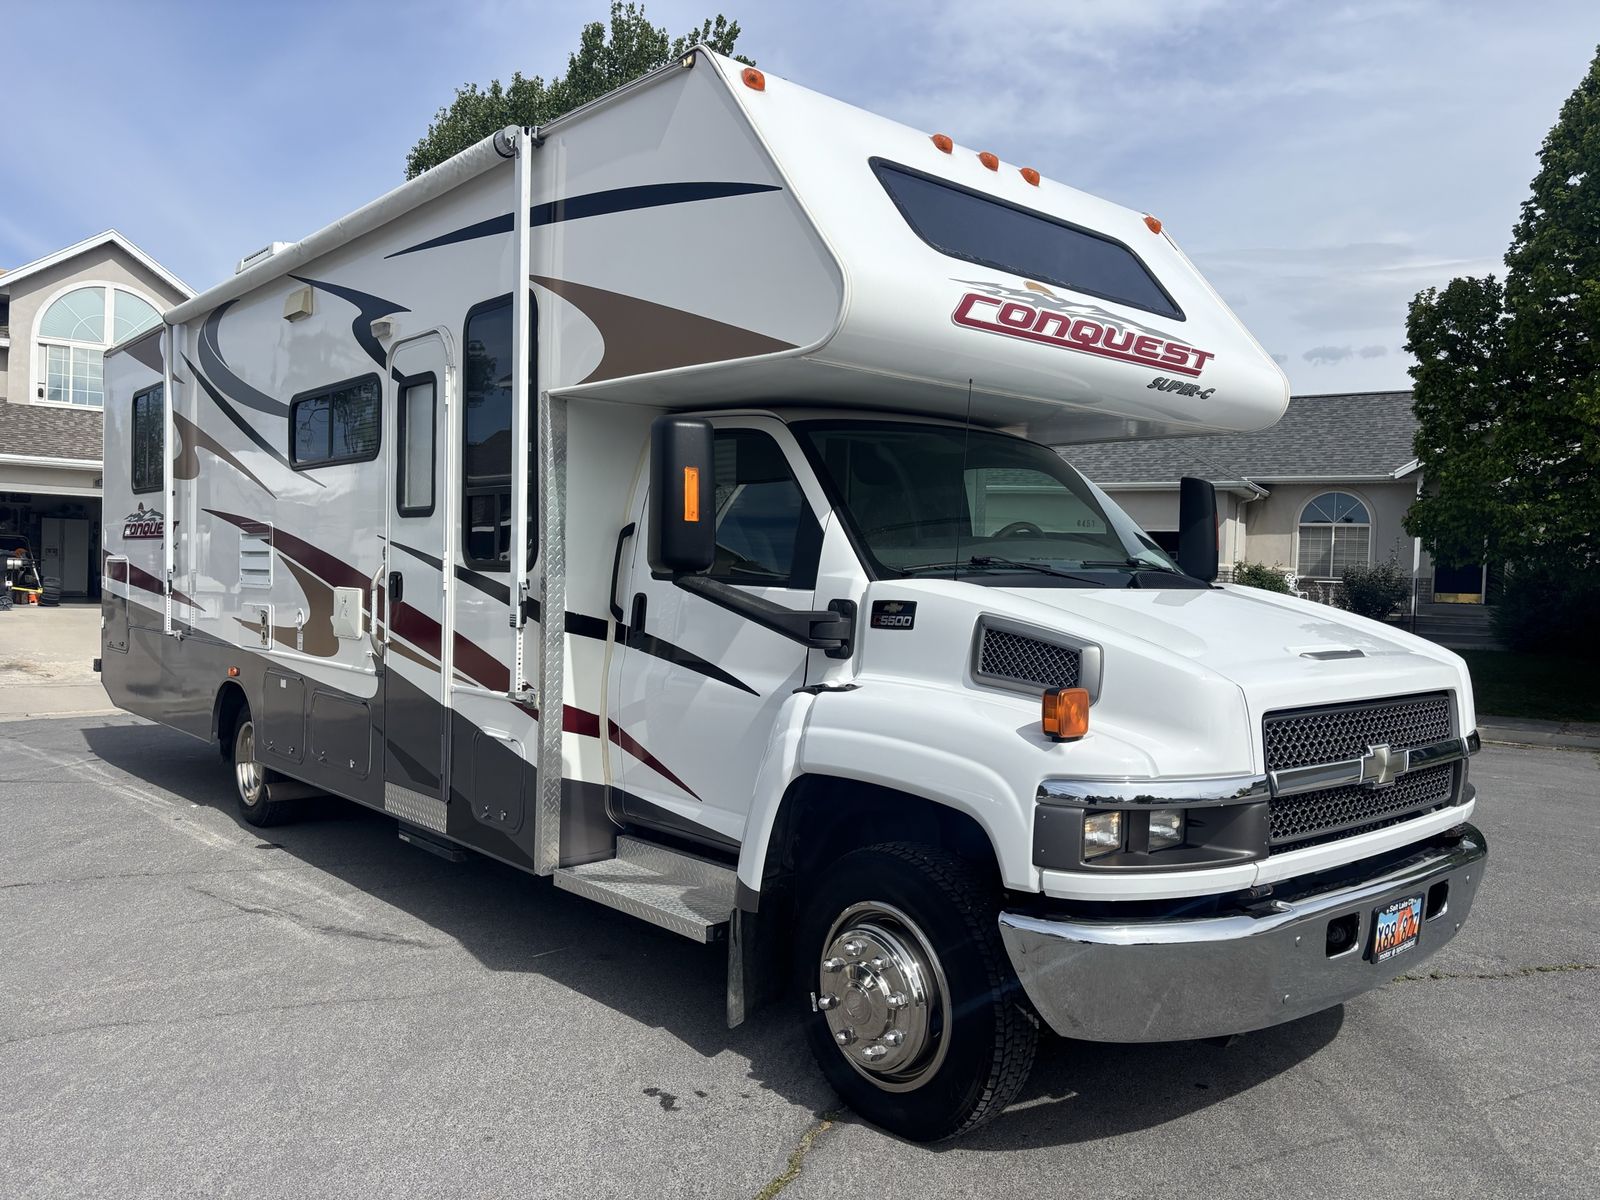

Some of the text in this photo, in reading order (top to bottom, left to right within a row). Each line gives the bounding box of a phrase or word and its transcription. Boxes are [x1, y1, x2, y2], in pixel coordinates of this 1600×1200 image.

[1146, 376, 1216, 400] SUPER-C
[122, 520, 180, 538] CONQUET
[872, 615, 912, 627] C5500
